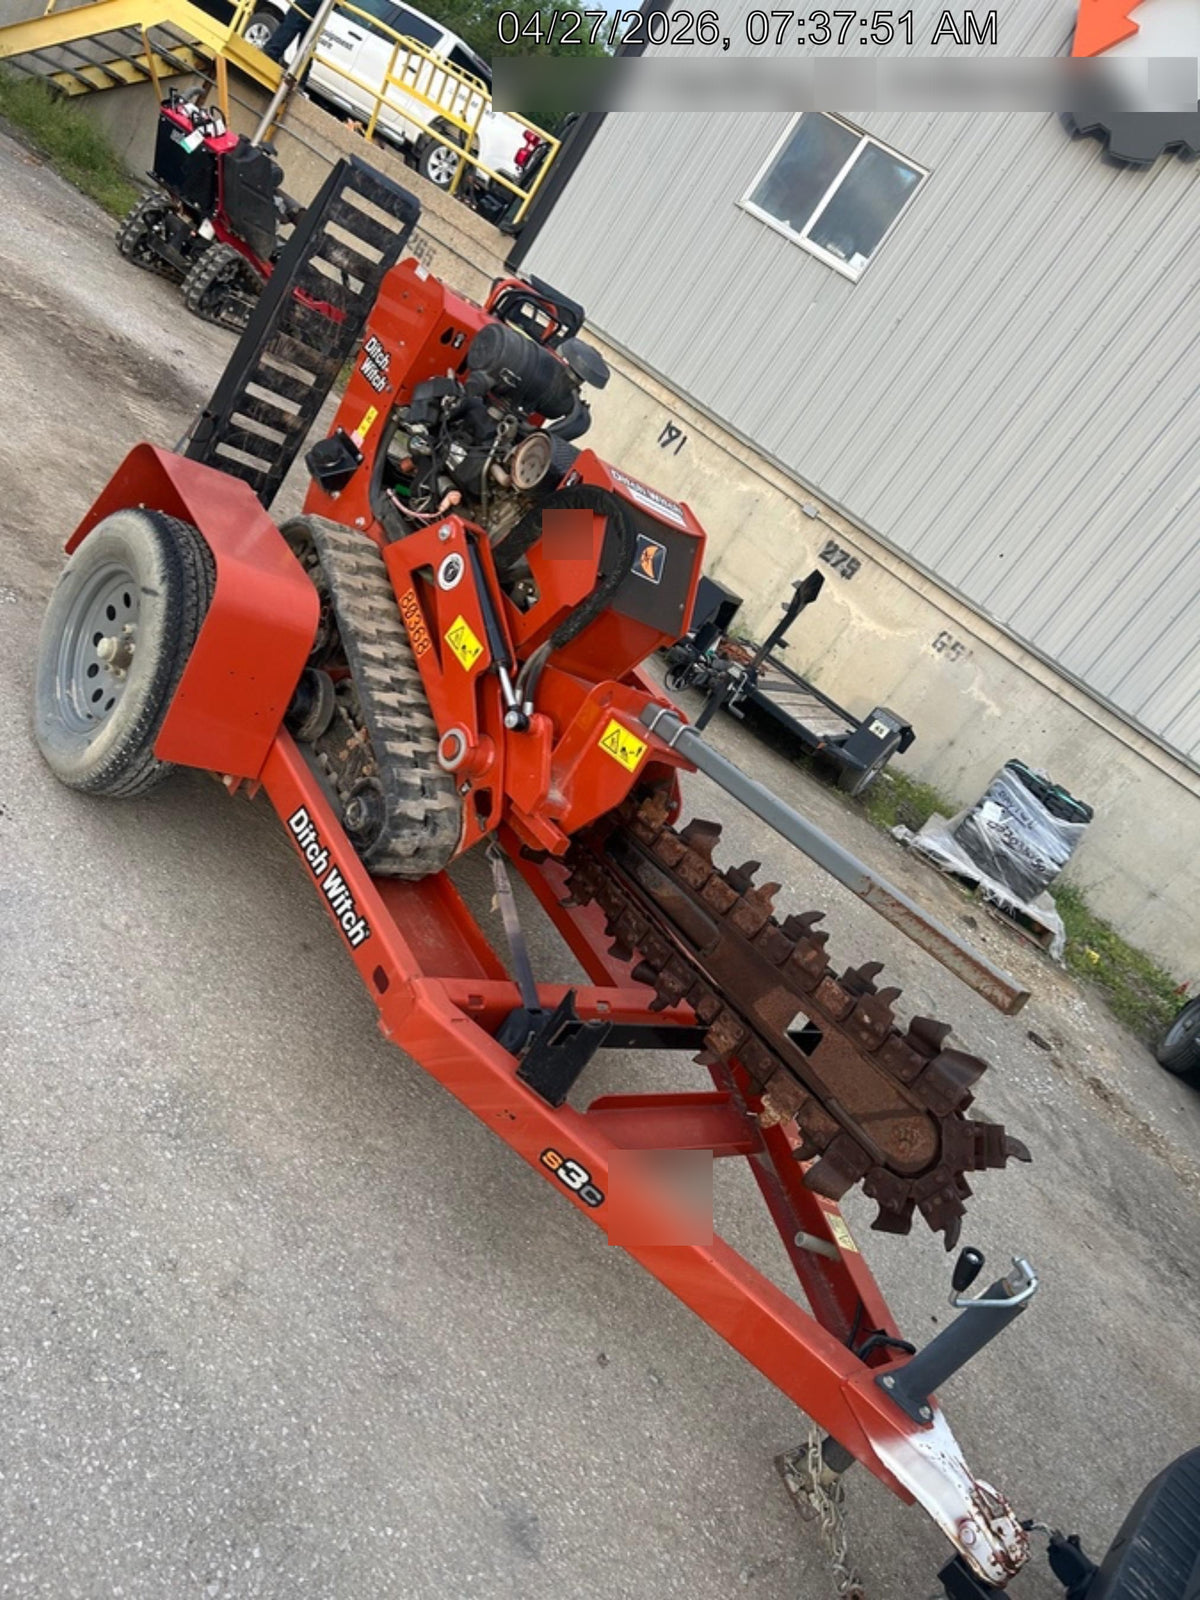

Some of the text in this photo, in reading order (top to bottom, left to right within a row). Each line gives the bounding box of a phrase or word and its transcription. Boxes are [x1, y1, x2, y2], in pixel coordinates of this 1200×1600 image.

[363, 335, 391, 371] Ditch
[359, 355, 388, 393] Witch
[657, 419, 688, 456] 191
[287, 804, 370, 949] Ditch Witch
